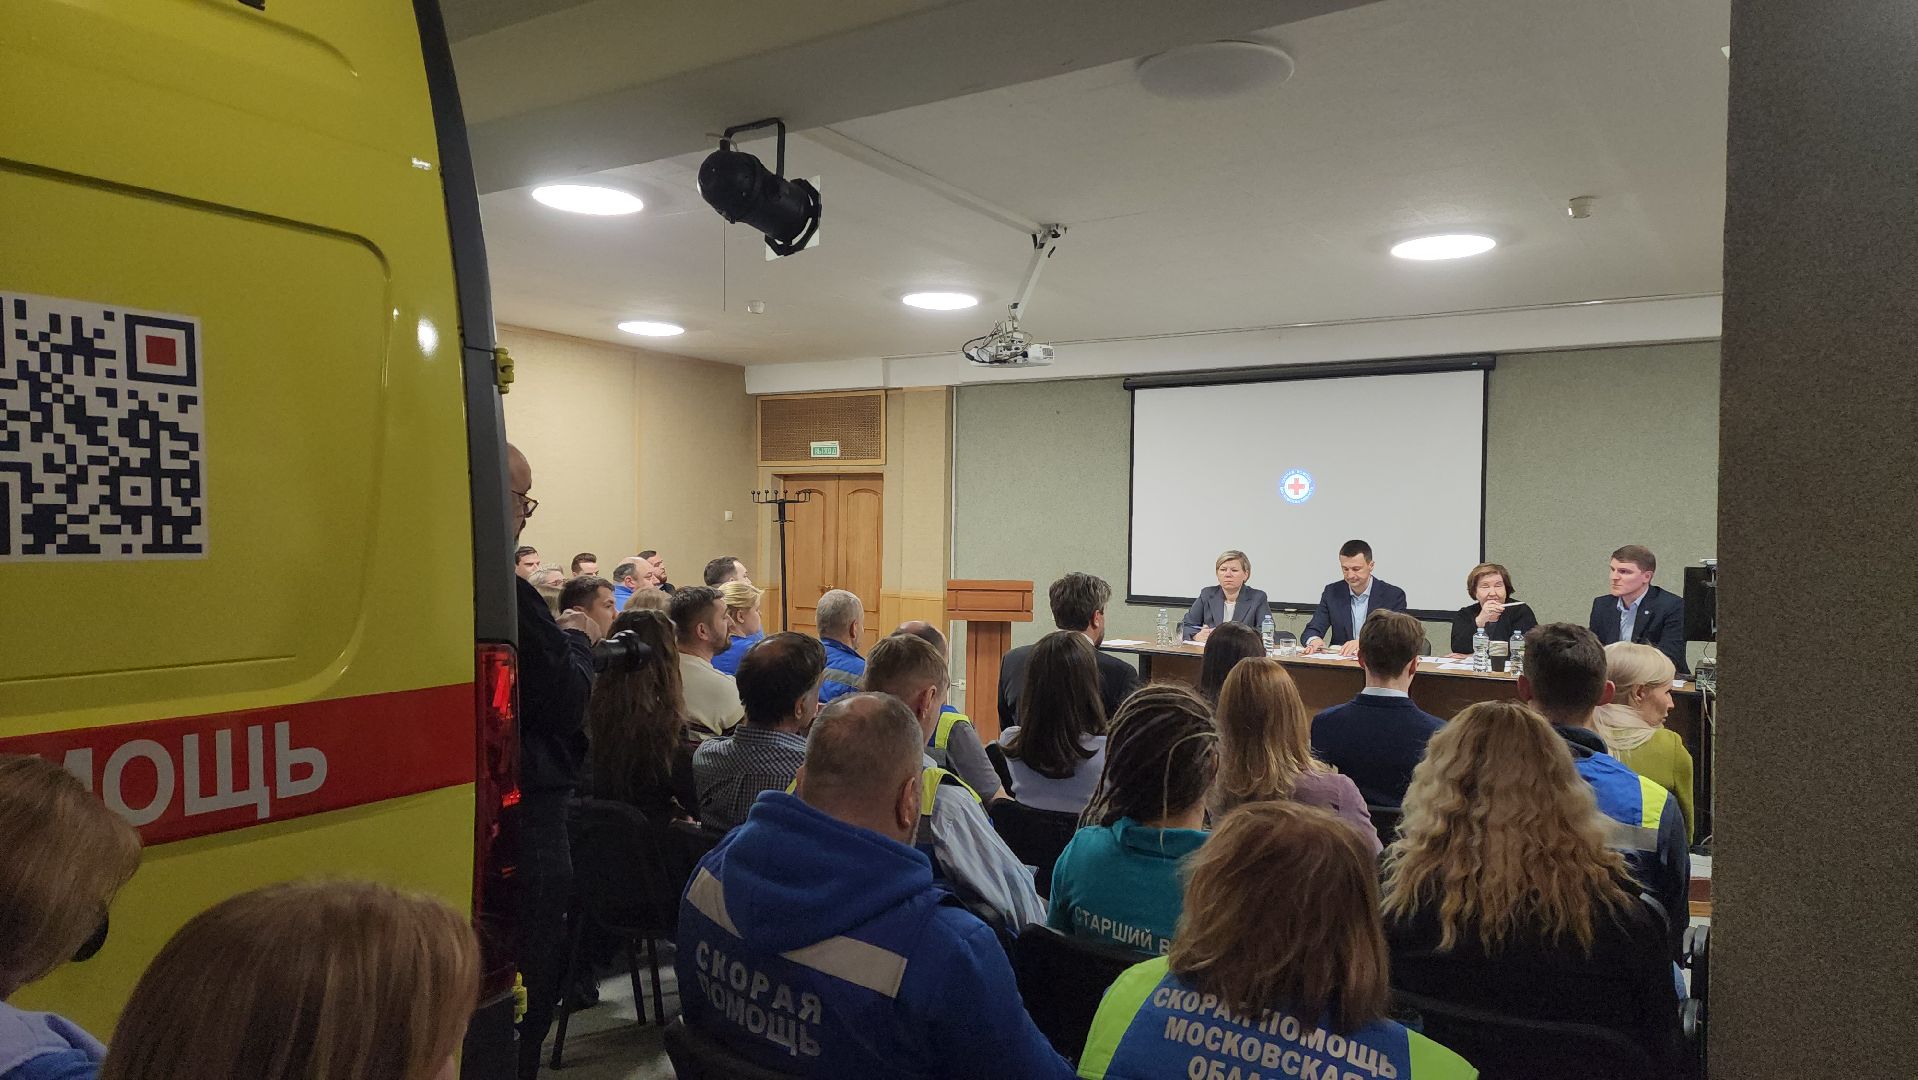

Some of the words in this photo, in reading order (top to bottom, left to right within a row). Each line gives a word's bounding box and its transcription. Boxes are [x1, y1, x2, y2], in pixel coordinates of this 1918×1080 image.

[29, 721, 328, 827] ОЩЬ
[1074, 906, 1153, 951] СТАРШИЙ
[696, 941, 822, 1025] СКОРАЯ
[696, 970, 822, 1057] ПОМОЩЬ
